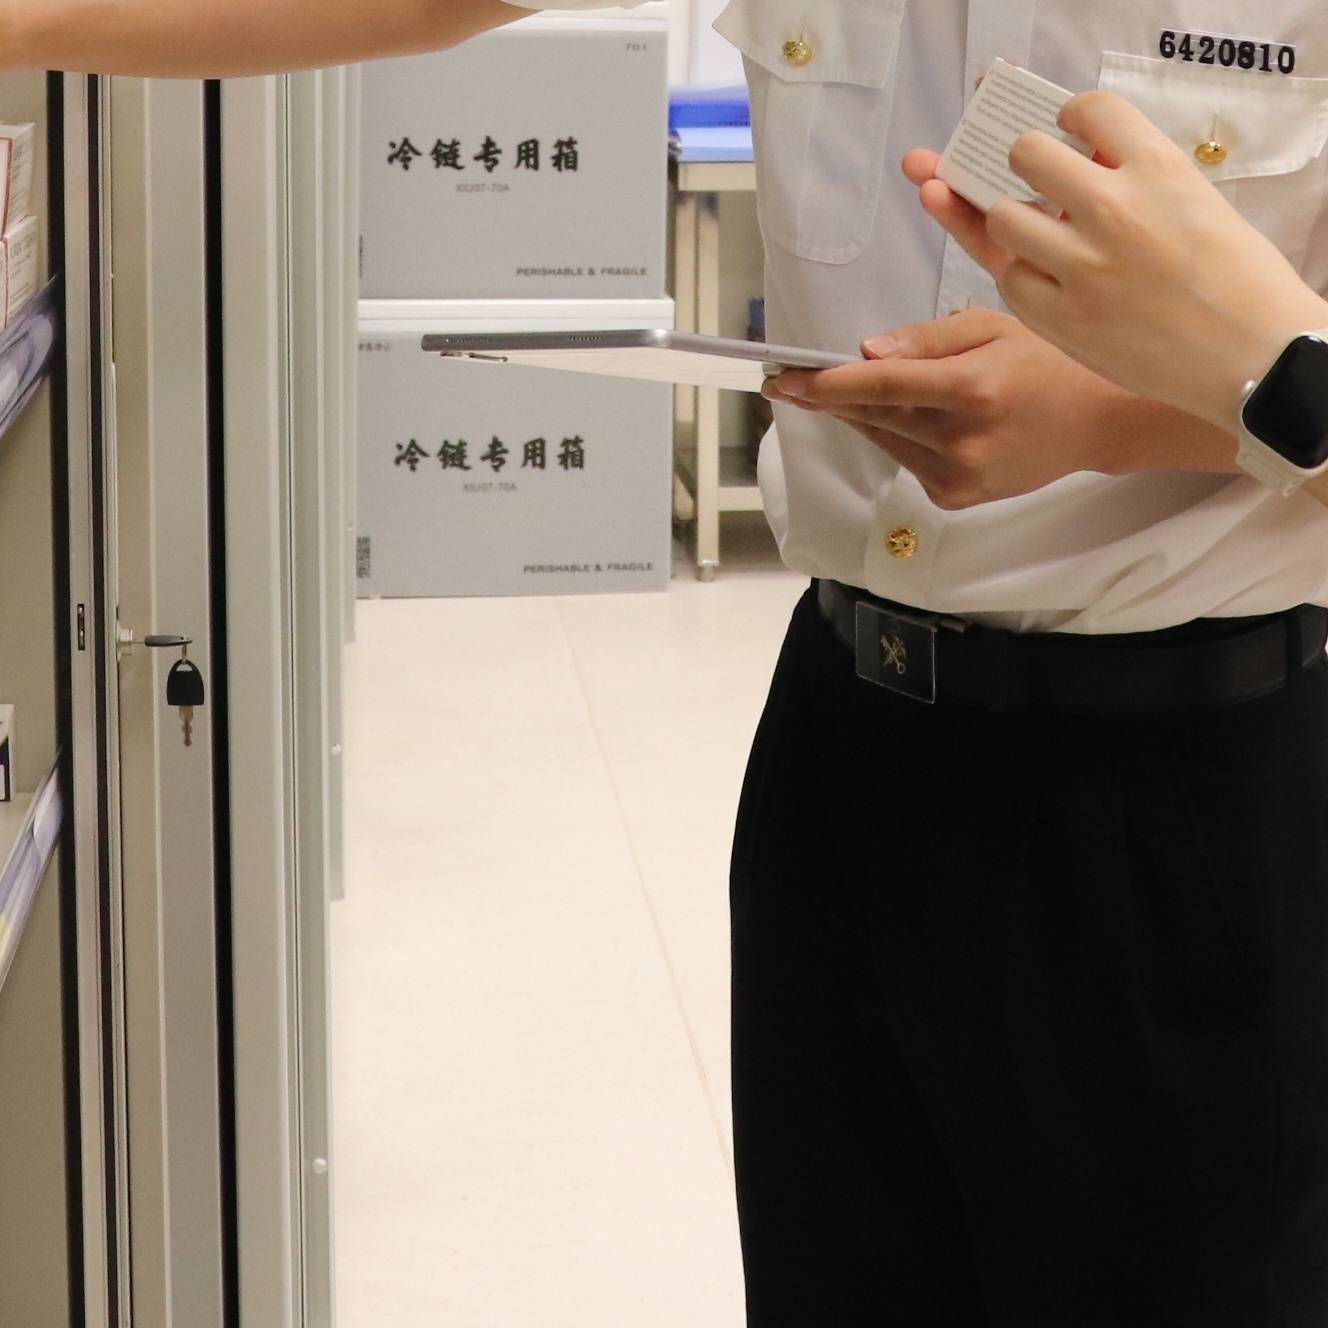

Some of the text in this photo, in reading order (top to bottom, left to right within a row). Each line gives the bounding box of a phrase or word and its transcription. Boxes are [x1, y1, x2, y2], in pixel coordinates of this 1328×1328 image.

[1159, 30, 1295, 74] 6420810
[387, 135, 579, 173] 冷链专用箱
[516, 267, 647, 276] PERISHABLE & FRAGILE
[394, 435, 585, 473] 冷链专用箱
[607, 562, 653, 571] FRAGILE
